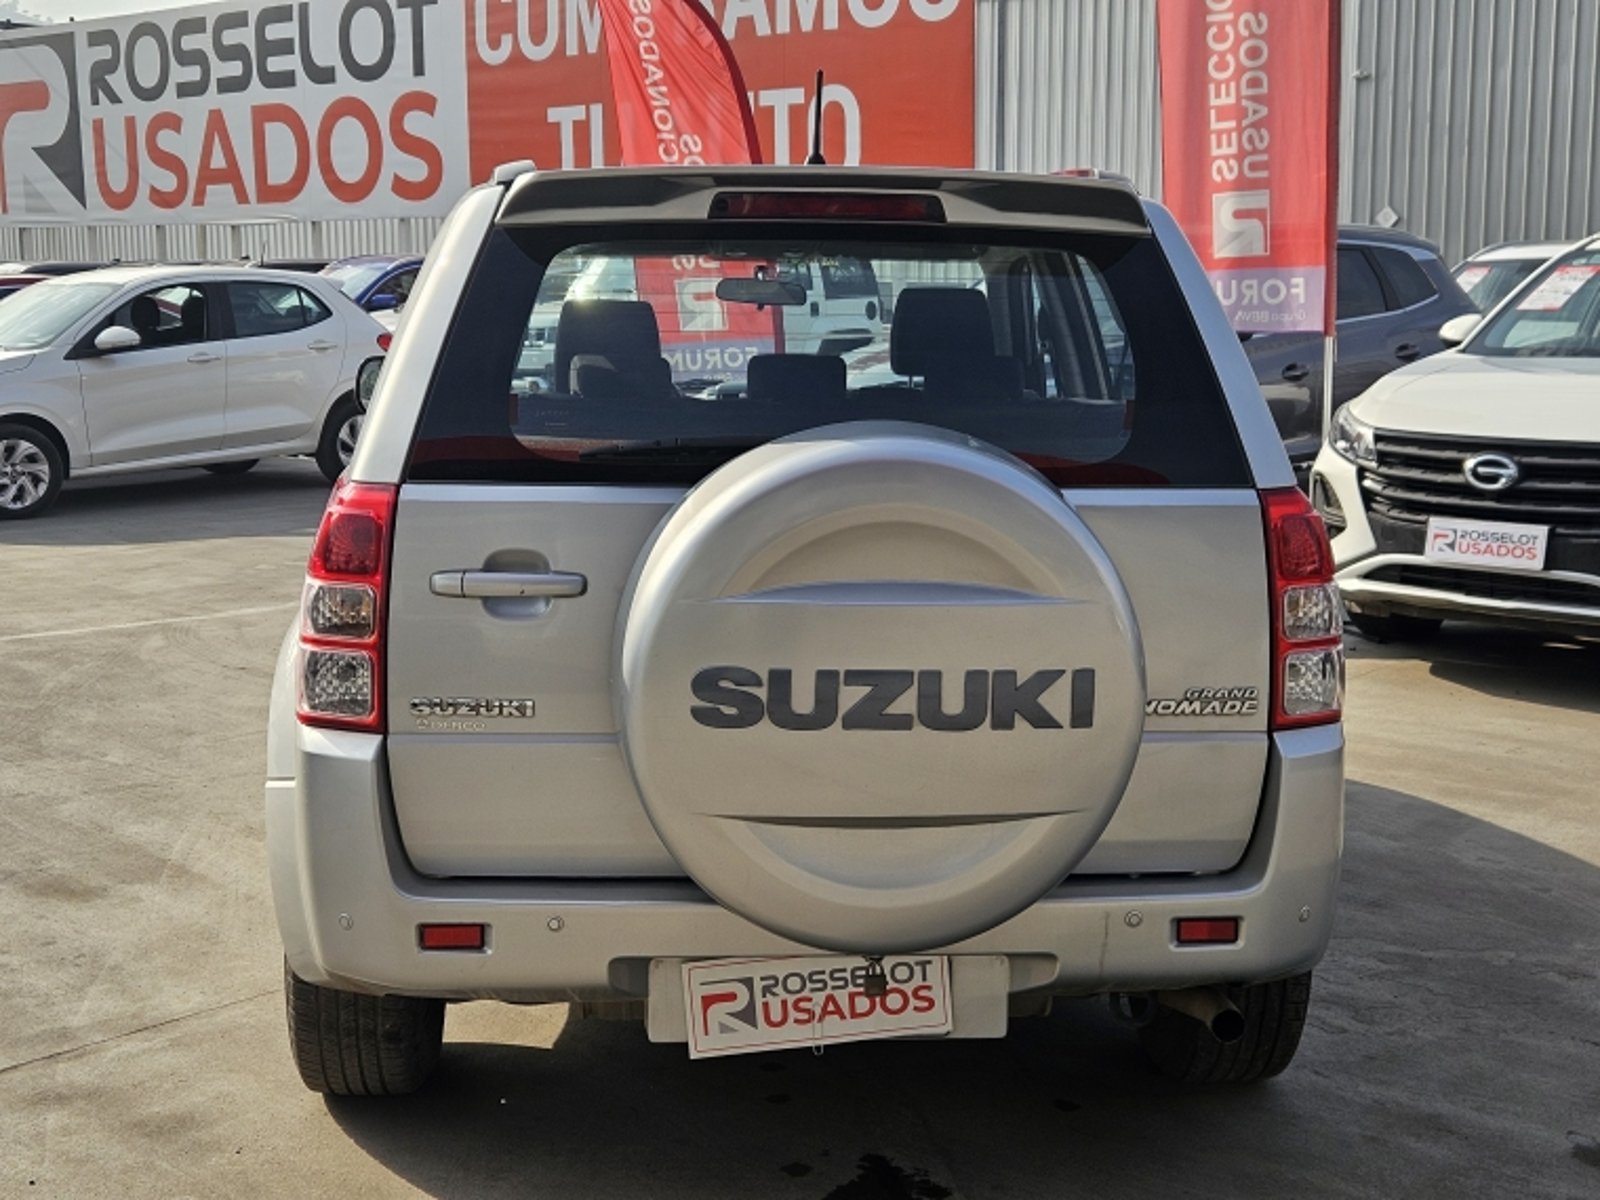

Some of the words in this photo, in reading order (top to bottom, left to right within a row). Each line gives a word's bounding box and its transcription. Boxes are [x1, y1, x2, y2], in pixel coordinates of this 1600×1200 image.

[87, 0, 438, 106] ROSSELOT
[92, 91, 443, 210] USADOS
[1458, 542, 1537, 560] USADOS
[1459, 530, 1538, 546] ROSSELOT
[410, 697, 535, 717] SUZUKI
[690, 665, 1095, 731] SUZUKI
[1185, 686, 1258, 699] GRAND
[760, 960, 933, 998] ROSSEOT
[762, 985, 936, 1028] USADOS
